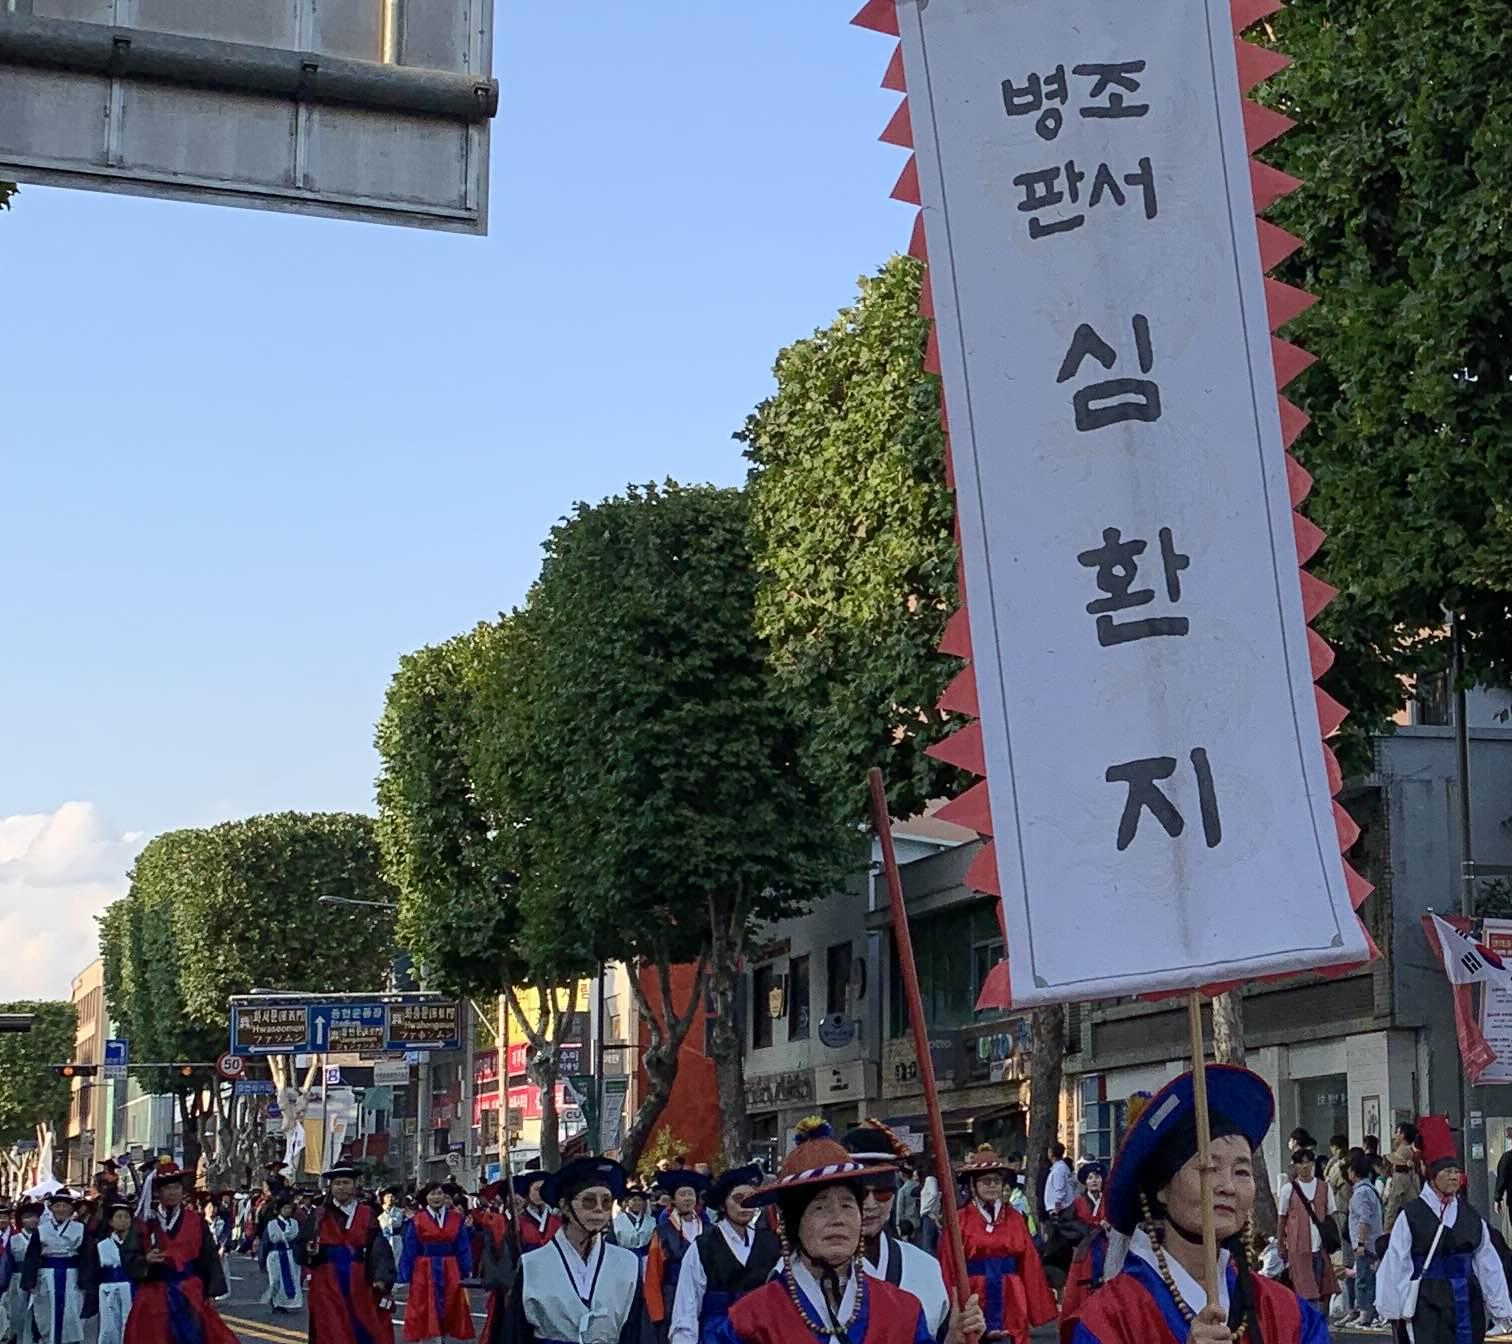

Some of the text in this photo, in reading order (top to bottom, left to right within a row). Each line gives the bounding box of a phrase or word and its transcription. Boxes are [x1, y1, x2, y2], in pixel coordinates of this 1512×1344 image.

[1001, 59, 1150, 141] 병조
[1012, 156, 1159, 240] 판서
[223, 1059, 241, 1071] 50
[566, 1111, 582, 1120] CU
